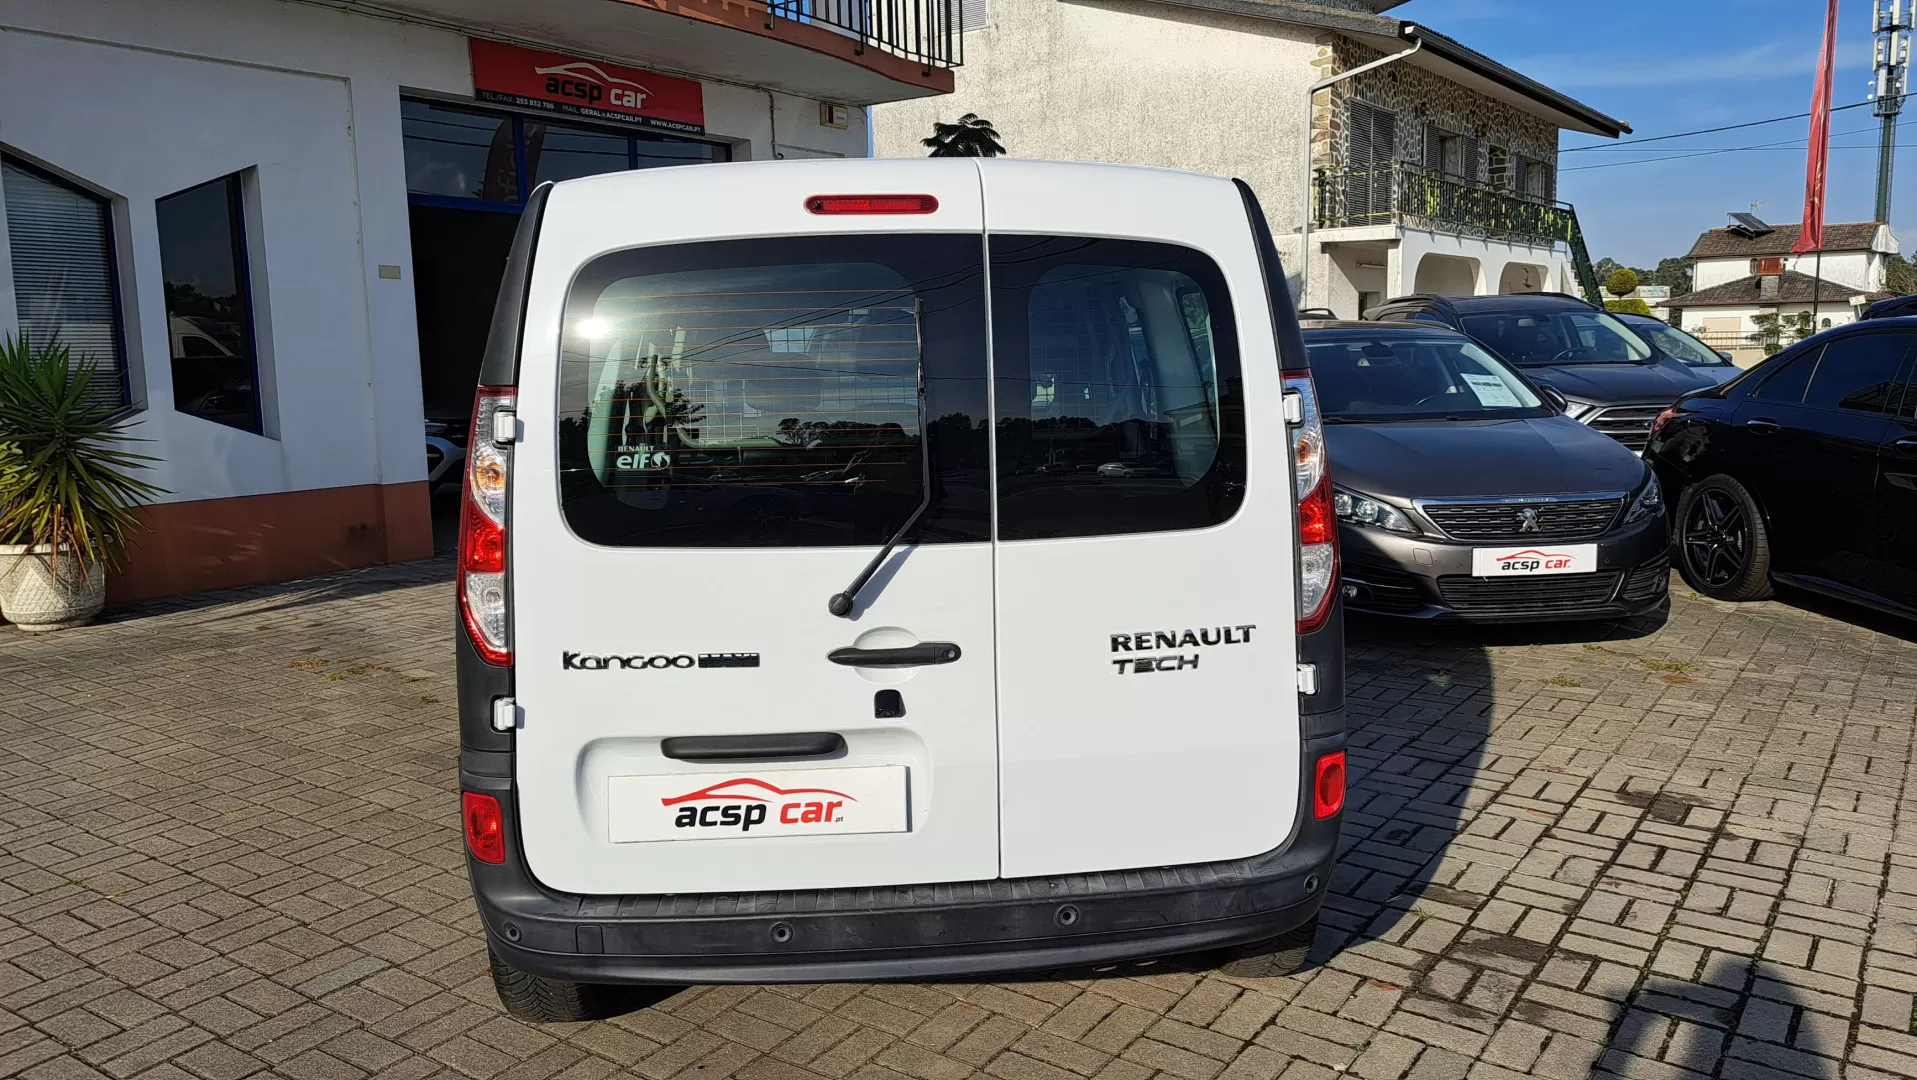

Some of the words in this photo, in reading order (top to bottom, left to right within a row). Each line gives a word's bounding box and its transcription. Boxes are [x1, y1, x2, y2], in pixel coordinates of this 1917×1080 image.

[545, 77, 602, 105] acsp
[610, 88, 646, 109] car
[516, 97, 529, 105] 253
[529, 99, 541, 107] 832
[650, 119, 701, 132] WWW.ACSPCAR.PT
[616, 453, 650, 469] elf
[1501, 560, 1540, 572] acsp
[1545, 559, 1571, 569] car
[1110, 624, 1256, 652] RENAULT
[562, 650, 695, 670] Kangoo
[1112, 653, 1199, 675] TECH
[674, 803, 767, 831] acsp
[779, 800, 843, 825] car
